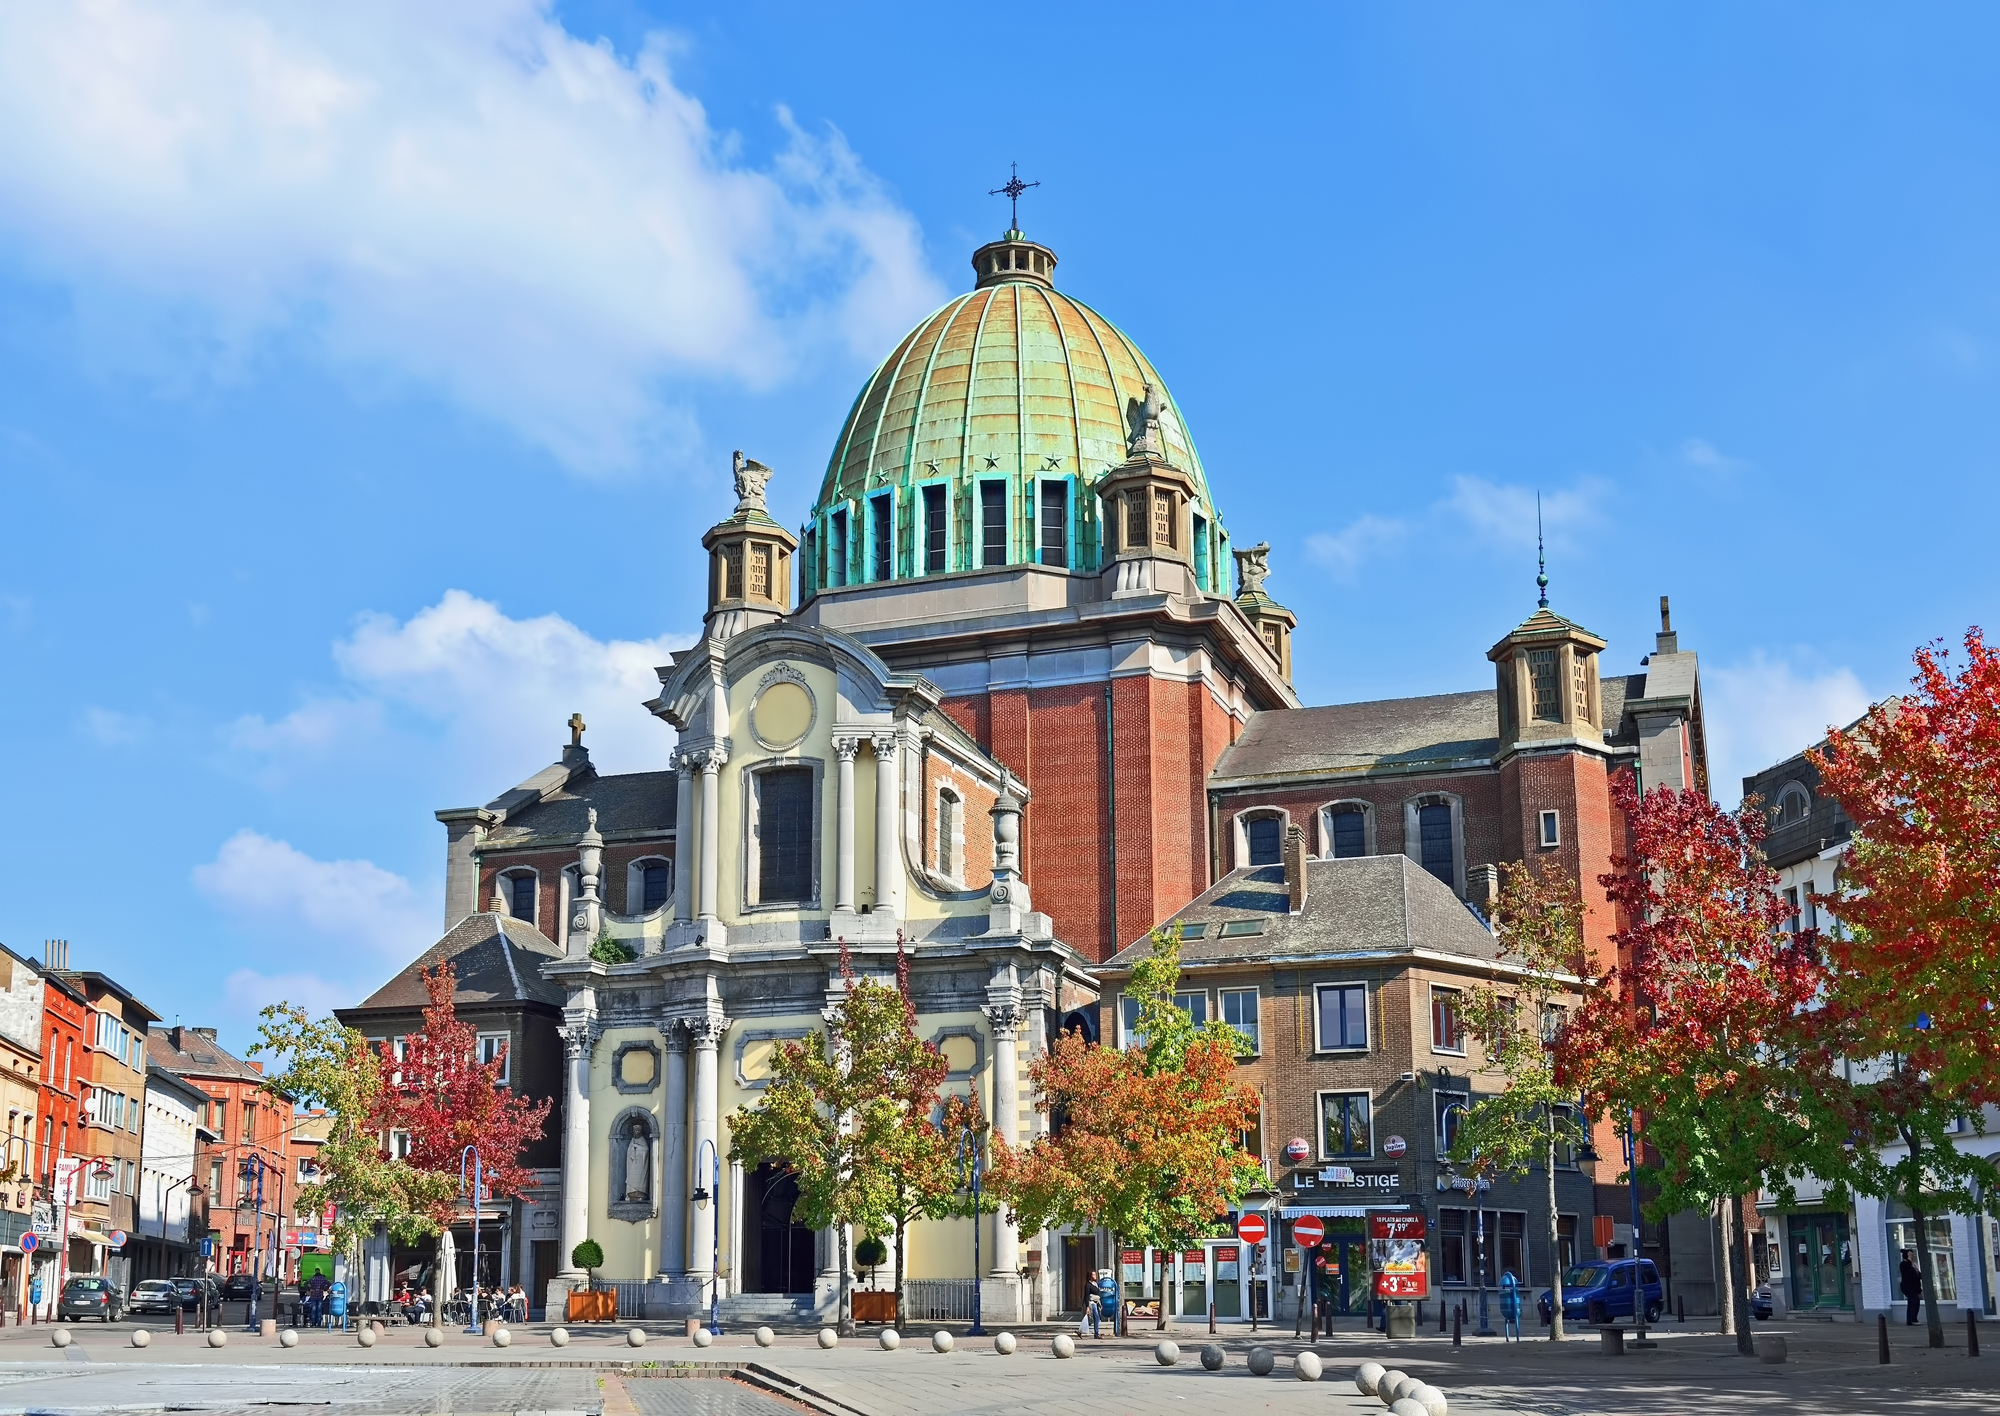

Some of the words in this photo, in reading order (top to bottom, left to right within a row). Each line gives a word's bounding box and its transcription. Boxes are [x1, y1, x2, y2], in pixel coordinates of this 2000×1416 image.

[58, 1163, 77, 1172] FAMILY
[59, 1177, 73, 1185] SHP
[1294, 1173, 1314, 1188] LE
[34, 1224, 49, 1232] Ria
